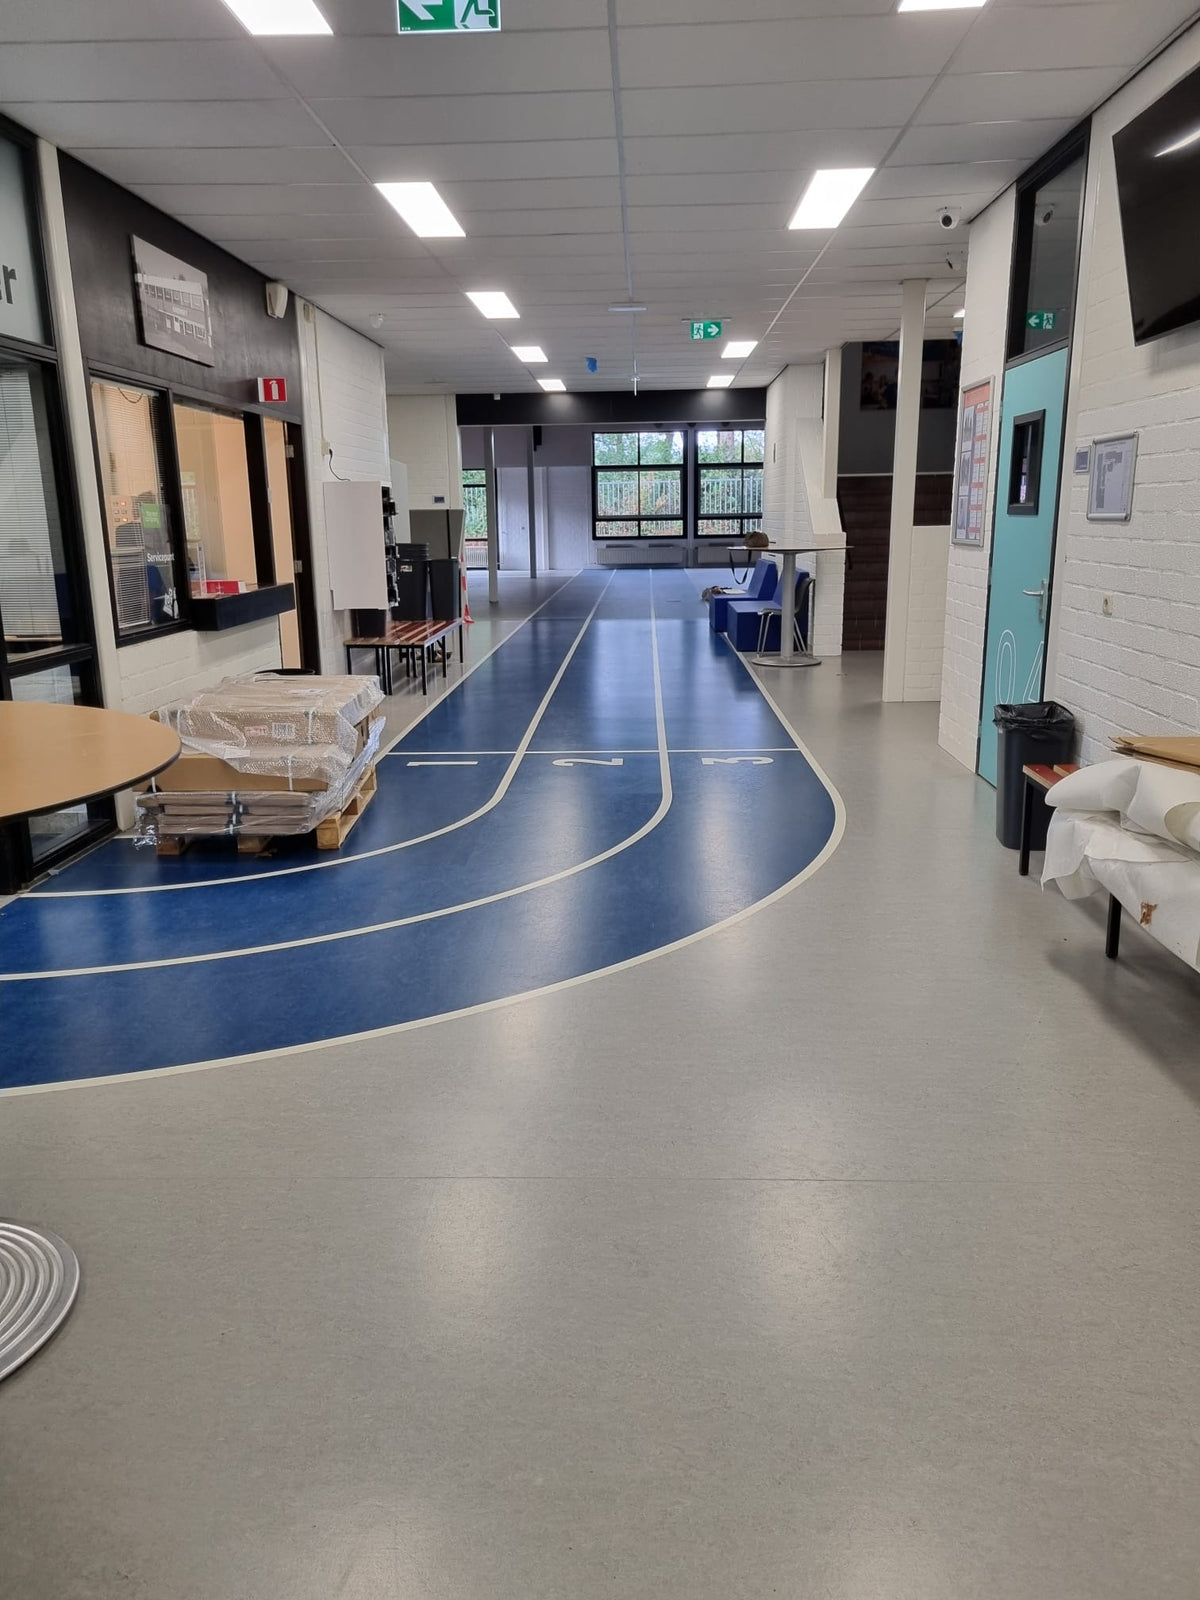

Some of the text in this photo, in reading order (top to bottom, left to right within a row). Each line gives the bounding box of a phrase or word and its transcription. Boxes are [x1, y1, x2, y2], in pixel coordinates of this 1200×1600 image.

[0, 264, 17, 304] r
[146, 551, 175, 564] Servicepunt
[551, 757, 624, 766] 2
[701, 756, 774, 765] 3
